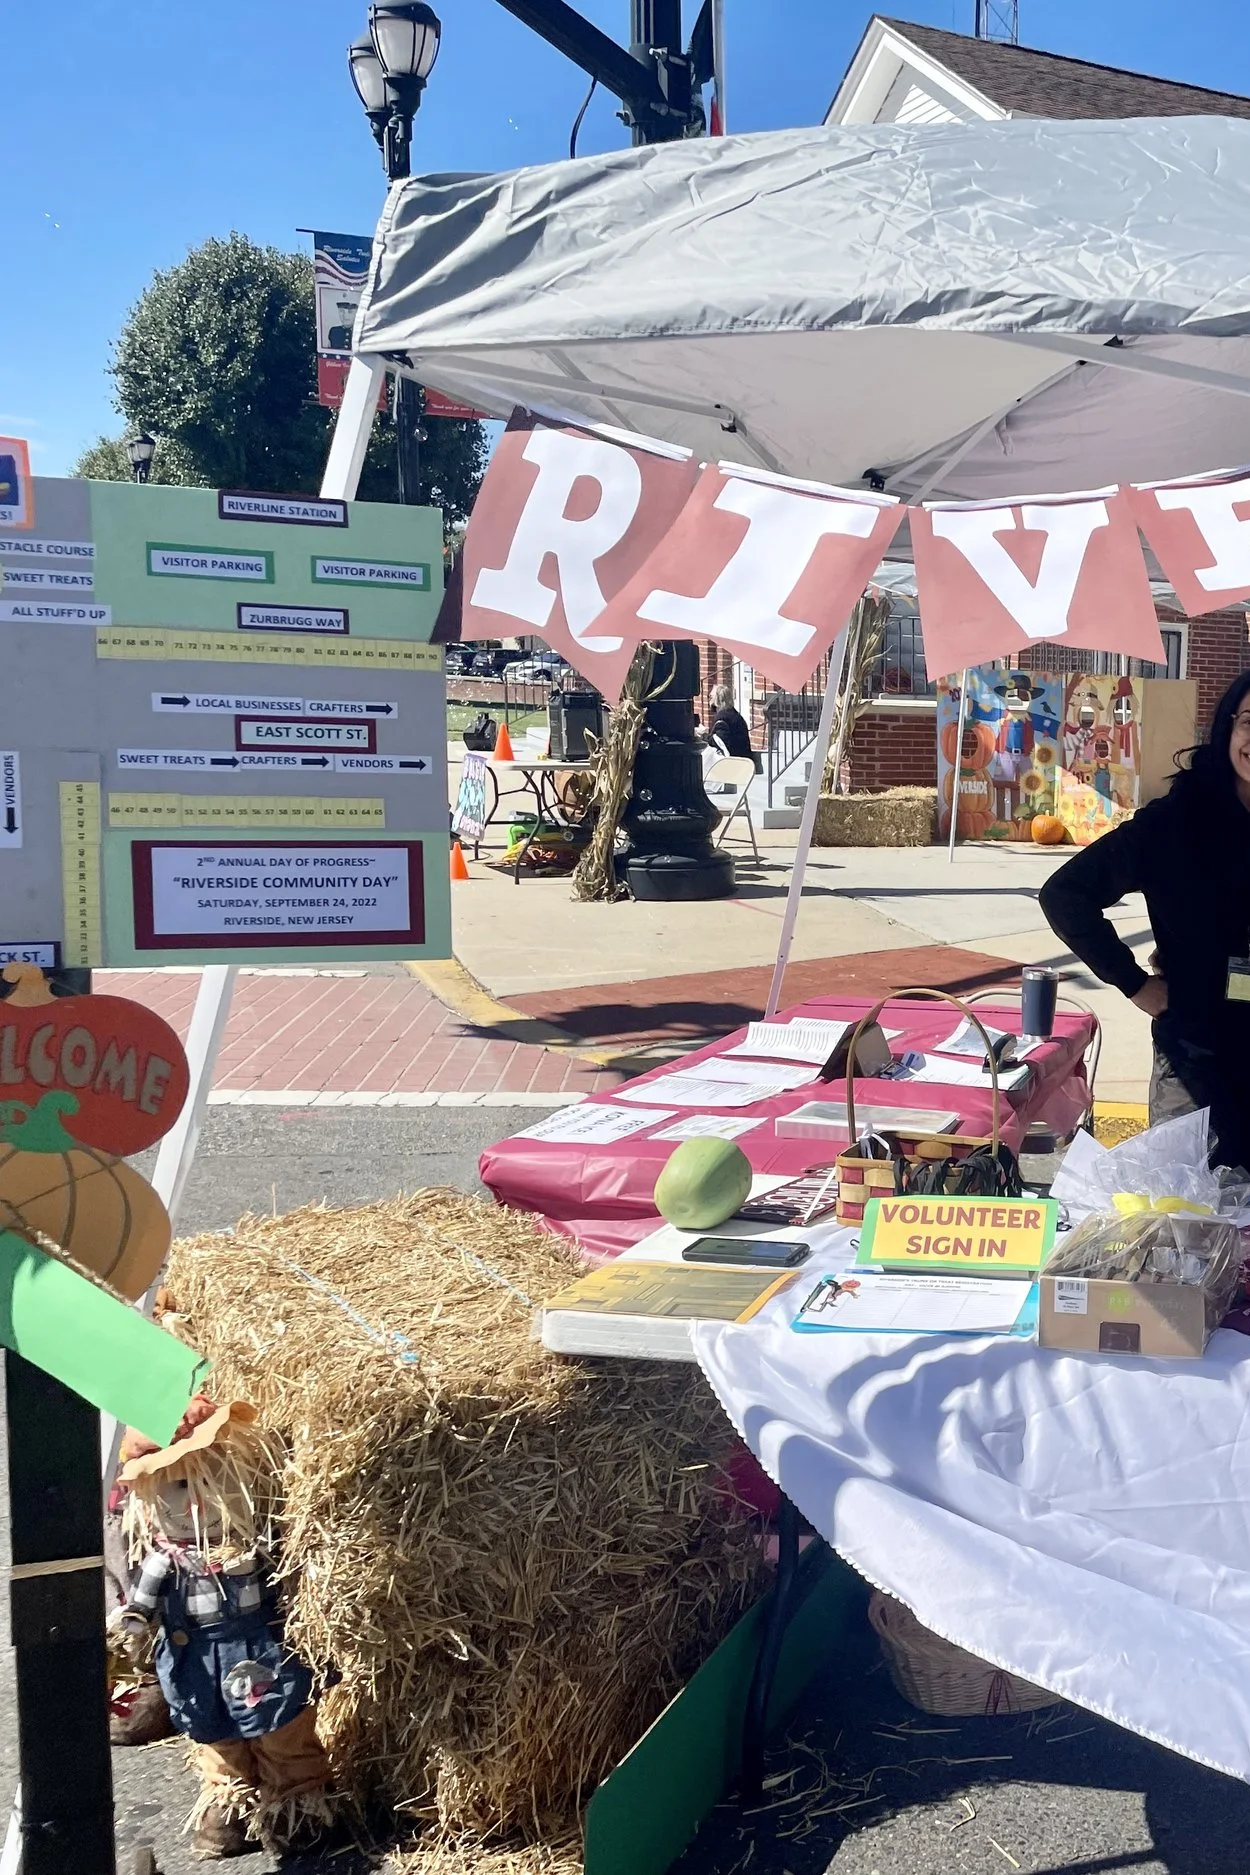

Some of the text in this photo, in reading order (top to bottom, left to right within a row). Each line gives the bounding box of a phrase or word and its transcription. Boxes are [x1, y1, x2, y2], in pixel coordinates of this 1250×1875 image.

[228, 500, 337, 519] RIVERLINE STATION
[46, 544, 95, 557] COURSE
[161, 556, 263, 572] VISITOR PARKING
[3, 571, 93, 586] SWEET TREATS
[322, 564, 417, 581] VISITOR PARKING
[12, 606, 107, 619] ALL STUFF'D UP
[250, 614, 342, 628] ZURBRUGG WAY
[195, 698, 301, 711] LOCAL BUSINESSES
[309, 702, 364, 713] CRAFTERS
[255, 726, 367, 740] EAST SCOTT ST.
[119, 754, 206, 765] SWEET TREATS
[241, 755, 297, 766] CRAFTERS
[341, 759, 394, 769] VENDORS
[3, 754, 15, 805] VENDORS
[218, 857, 267, 867] ANNUAL
[269, 857, 292, 867] DAY
[295, 857, 311, 867] OF
[262, 876, 359, 889] COMMUNITY
[197, 897, 377, 909] SATURDAY, SEPTEMBER 24, 2022
[223, 915, 354, 927] RIVERSIDE, NEW JERSEY
[22, 950, 46, 963] ST.
[0, 1022, 176, 1117] LCOME
[881, 1204, 1041, 1230] VOLUNTEER
[905, 1235, 1007, 1258] SIGN IN
